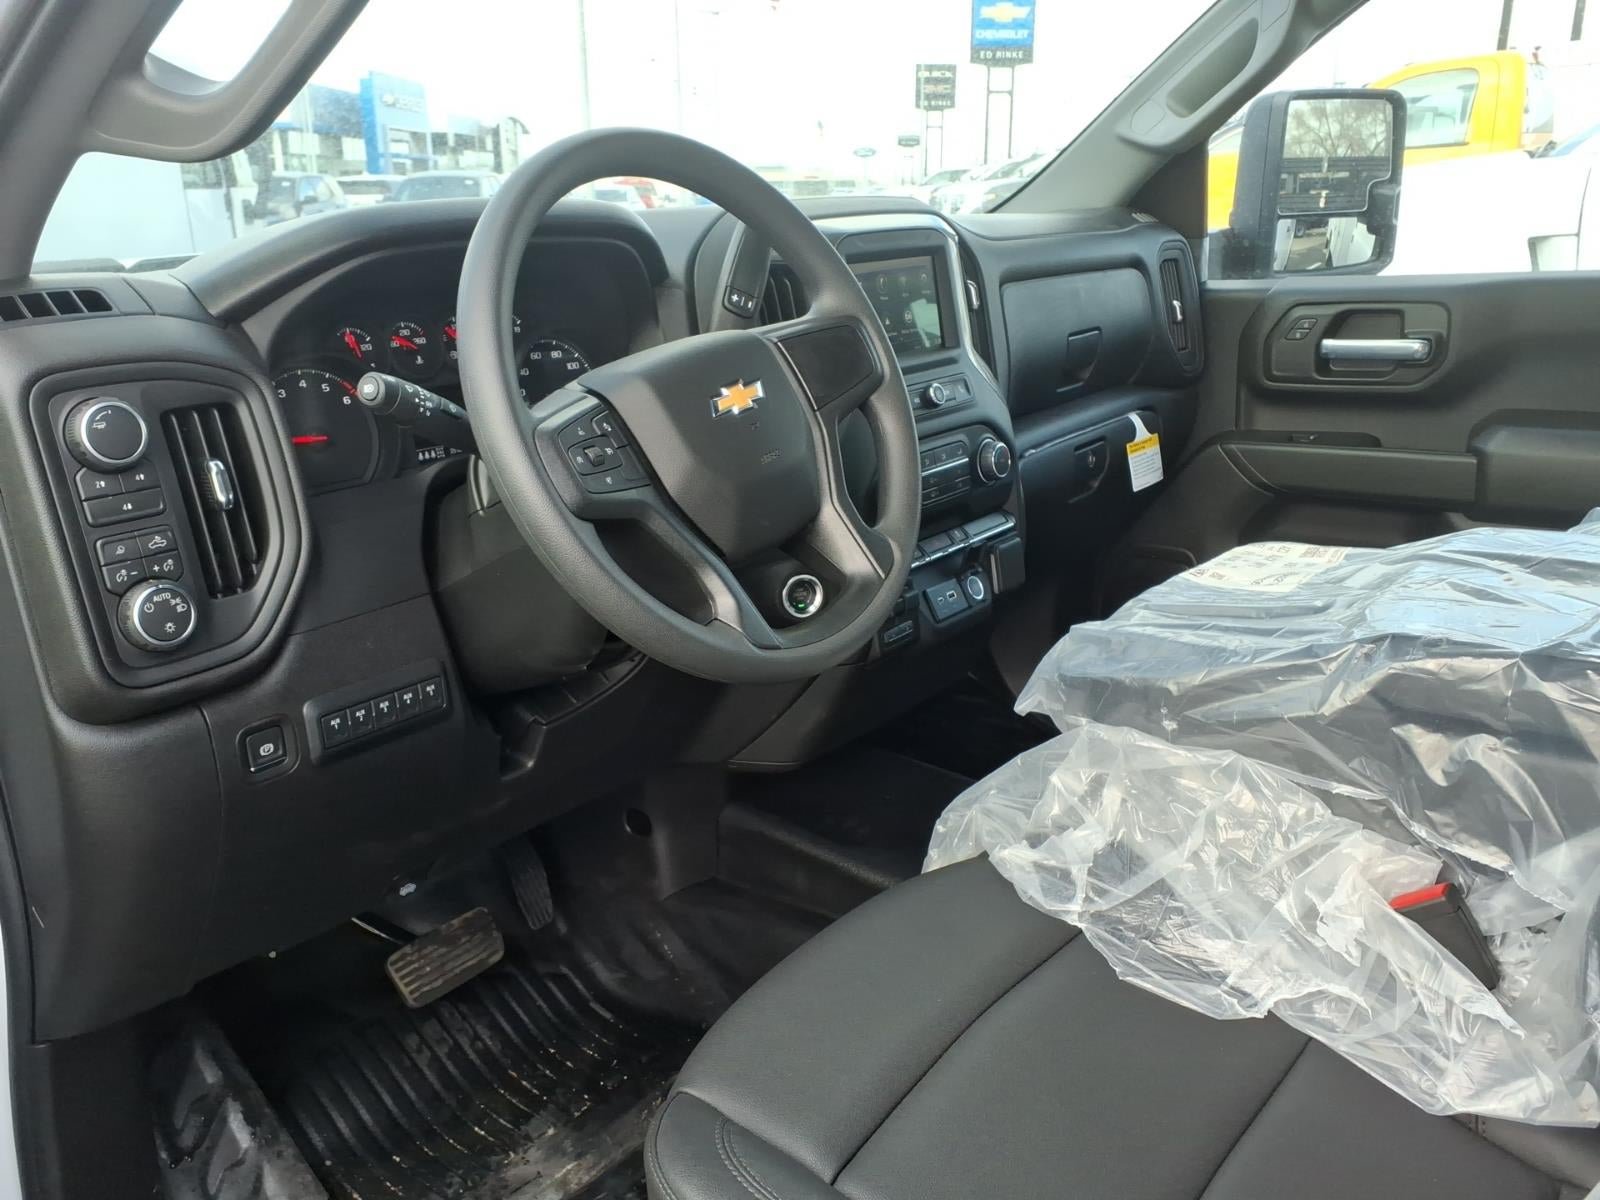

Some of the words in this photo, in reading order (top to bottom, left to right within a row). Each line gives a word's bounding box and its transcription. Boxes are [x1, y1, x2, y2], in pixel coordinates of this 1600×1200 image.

[980, 51, 993, 59] ED
[551, 350, 562, 359] 80
[566, 362, 580, 370] 100
[298, 380, 307, 388] 4
[321, 384, 330, 393] 5
[277, 389, 287, 398] 3
[342, 396, 352, 405] 6
[153, 592, 171, 602] AUTO
